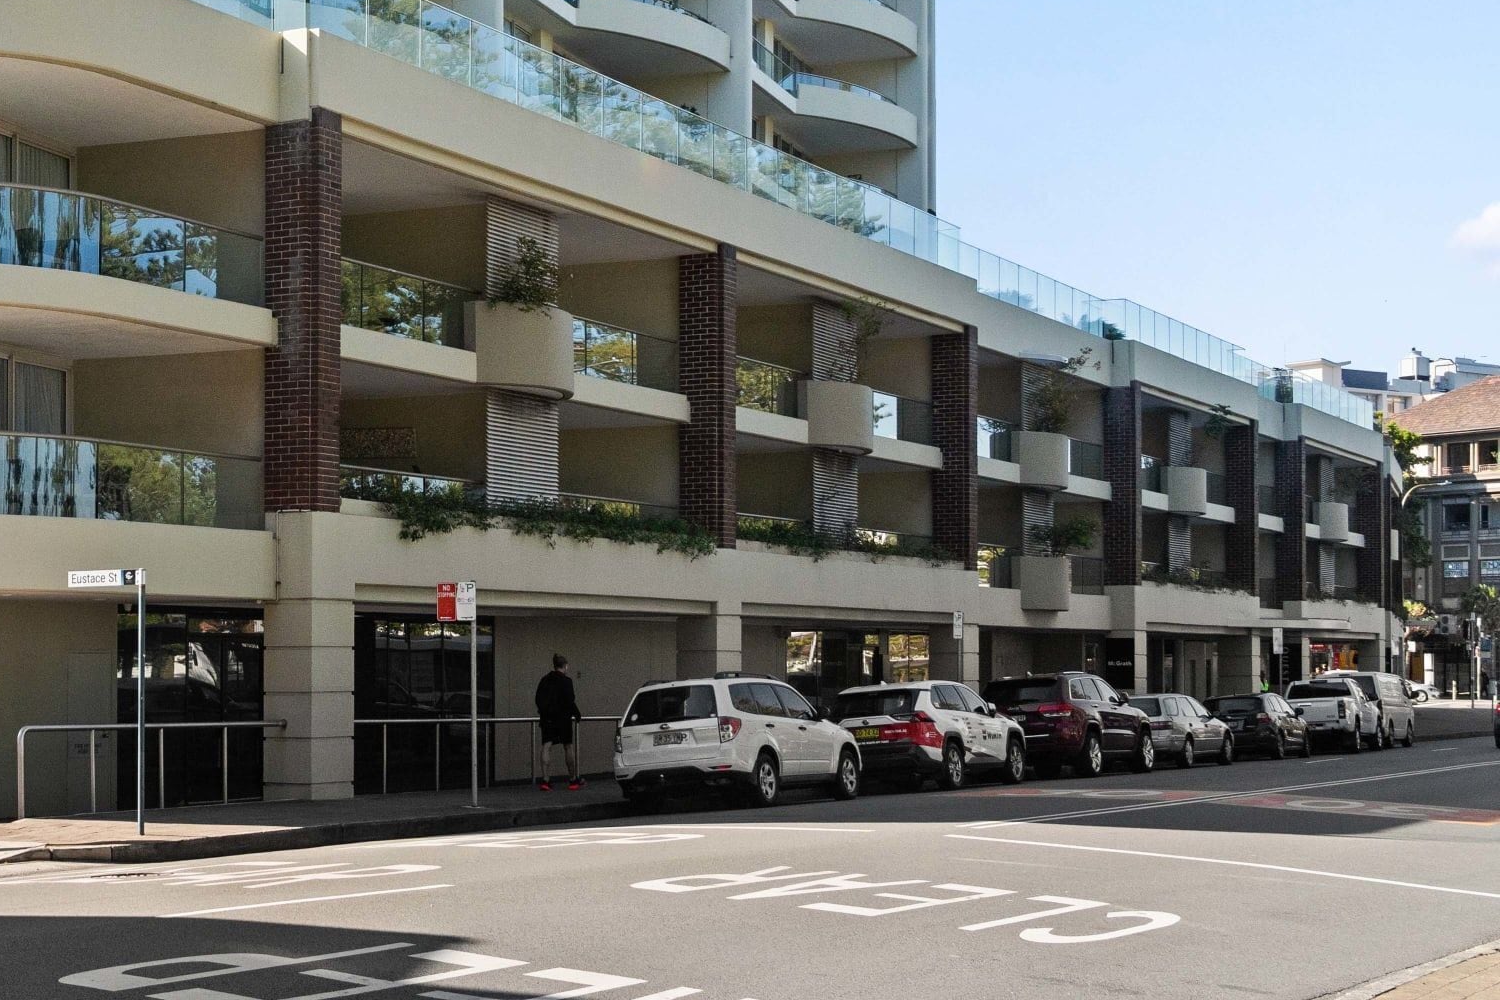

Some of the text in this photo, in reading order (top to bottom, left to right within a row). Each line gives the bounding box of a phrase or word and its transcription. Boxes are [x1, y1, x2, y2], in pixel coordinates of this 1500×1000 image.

[71, 572, 117, 584] Eustace St
[629, 865, 1181, 944] CLEAR
